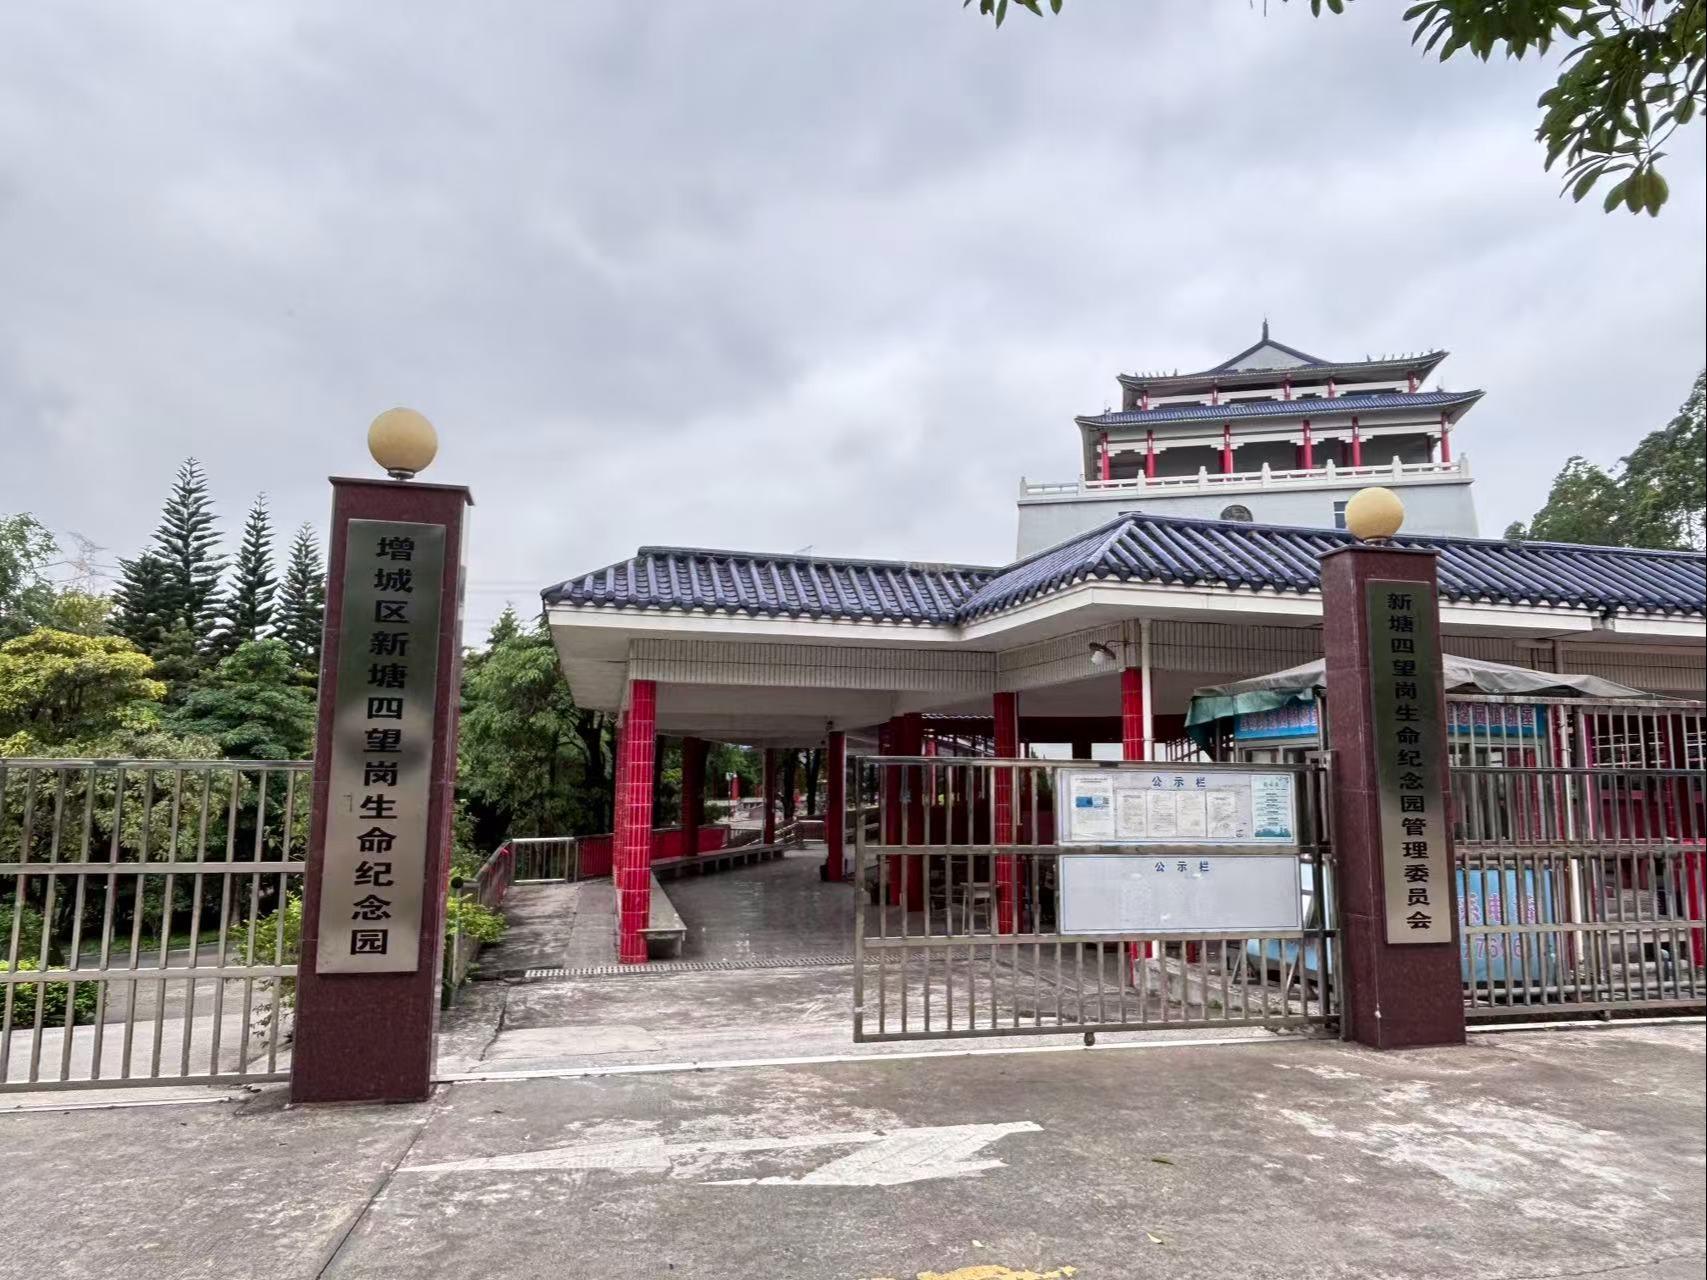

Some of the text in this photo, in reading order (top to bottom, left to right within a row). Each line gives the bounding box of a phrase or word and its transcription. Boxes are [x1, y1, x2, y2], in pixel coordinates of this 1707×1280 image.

[350, 536, 416, 956] 增城区新塘四望岗生命纪念园
[1152, 776, 1206, 788] 公示栏
[1387, 592, 1432, 930] 新塘四望岗生命纪念园管理委员会
[1155, 861, 1210, 873] 公示栏
